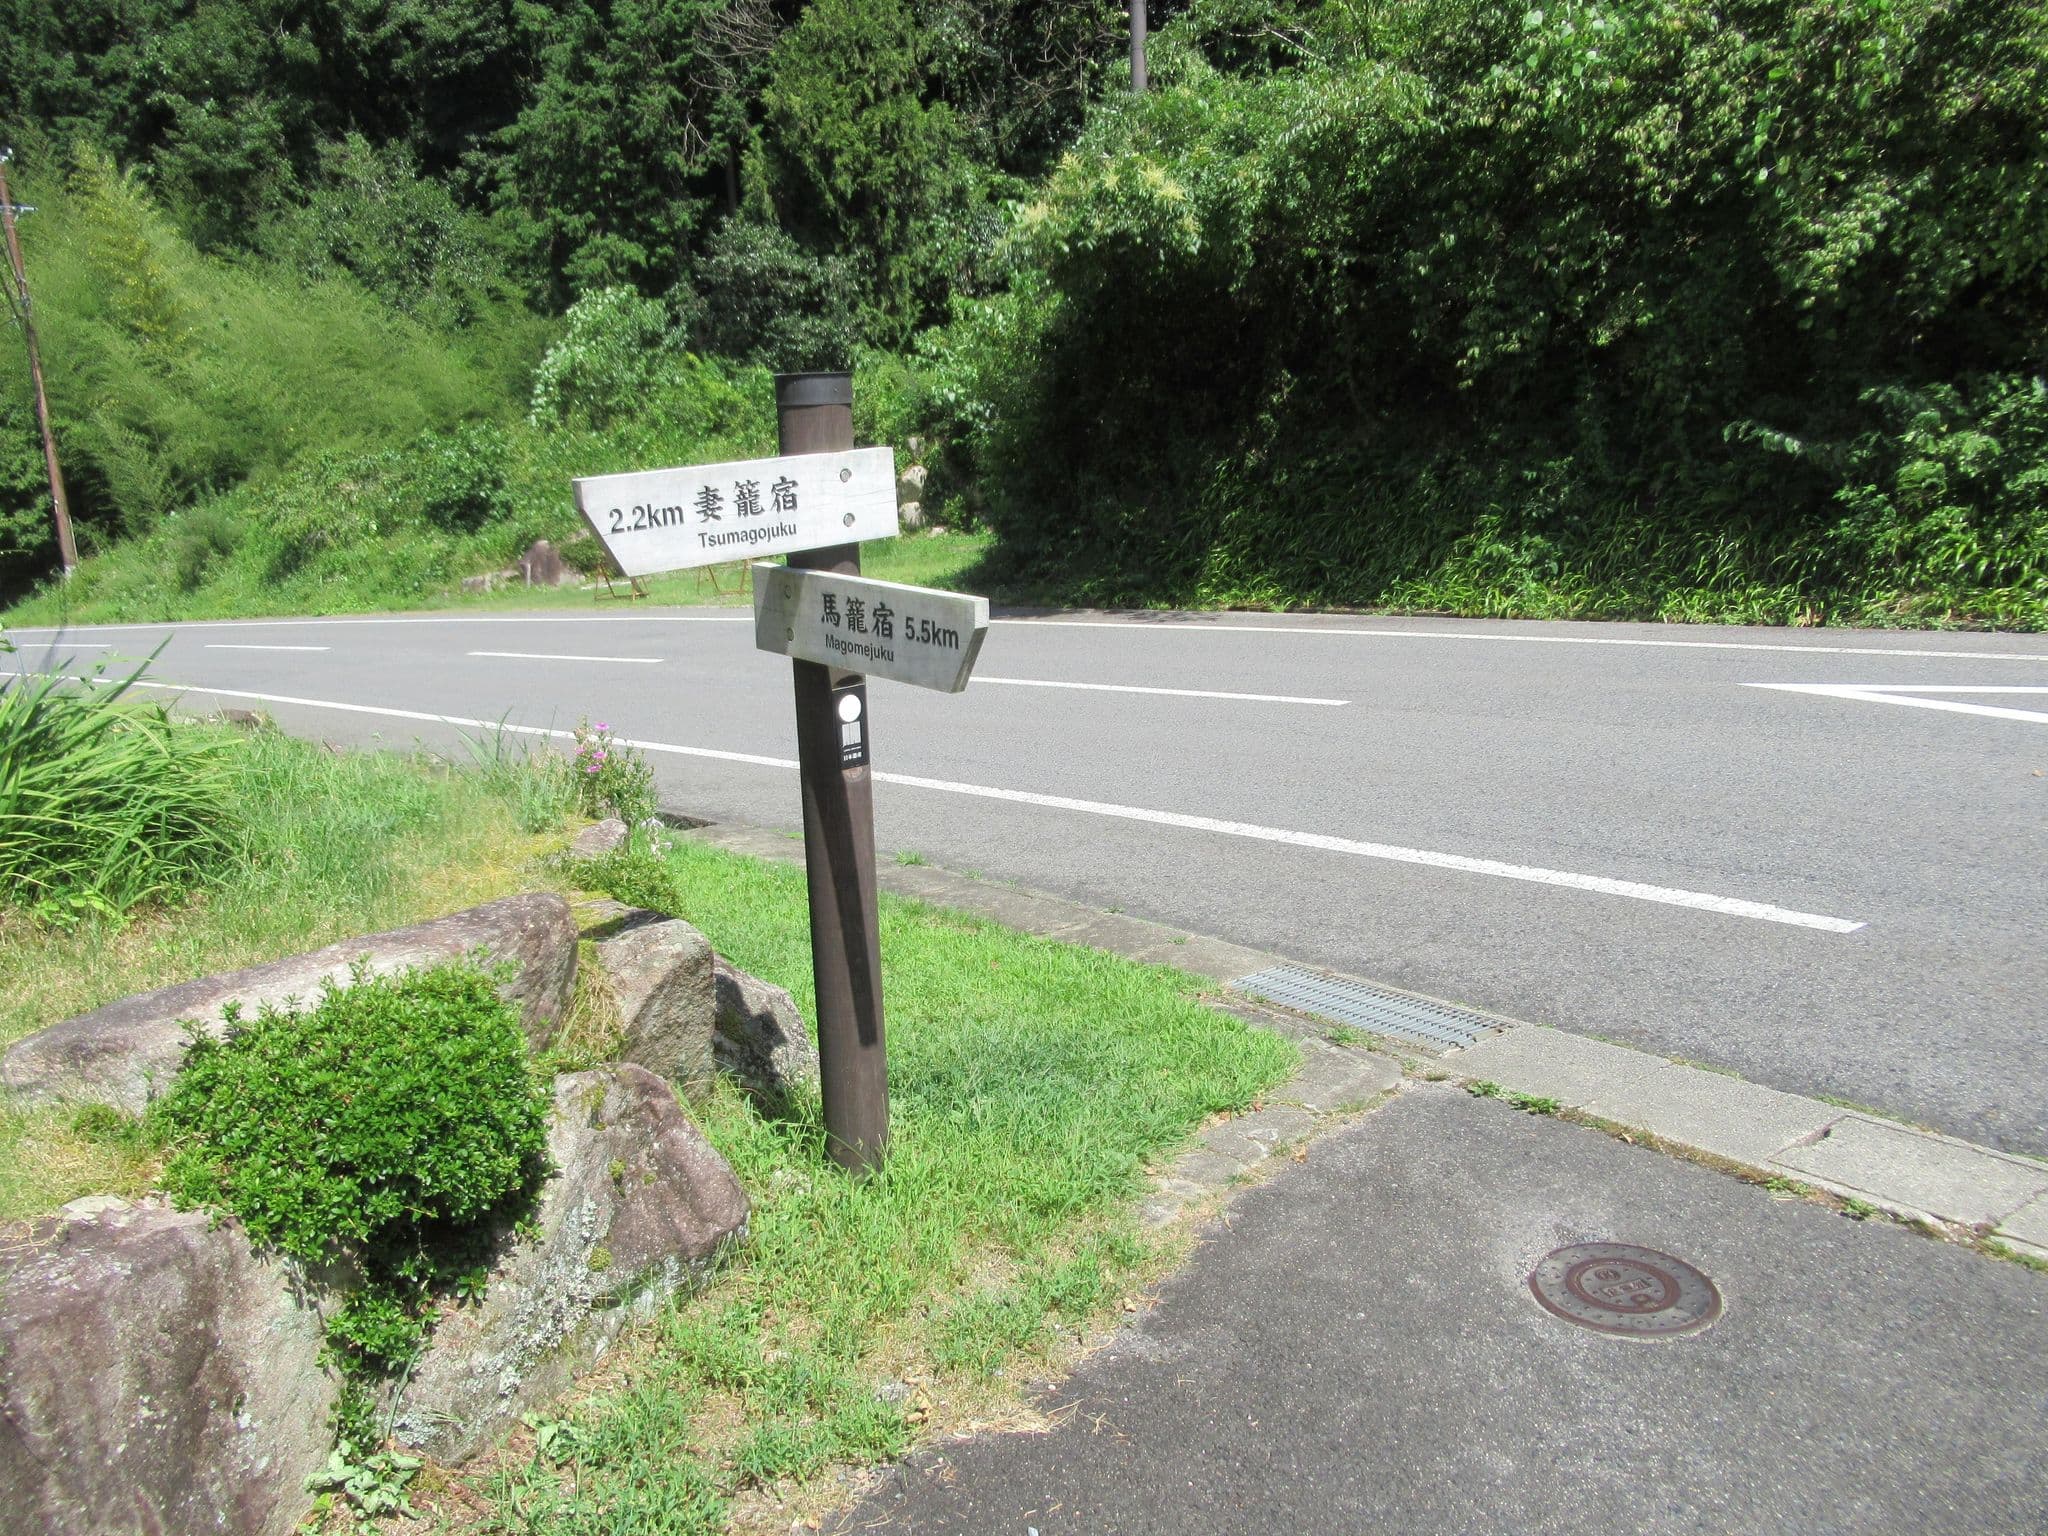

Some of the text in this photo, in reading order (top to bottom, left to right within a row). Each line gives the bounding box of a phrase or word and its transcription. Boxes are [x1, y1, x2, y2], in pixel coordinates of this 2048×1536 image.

[608, 475, 800, 535] 2.2km 妻籠宿
[697, 521, 798, 550] Tsumagojuku
[820, 592, 960, 650] 馬籠宿 5.5km
[824, 633, 895, 662] Magomejuku
